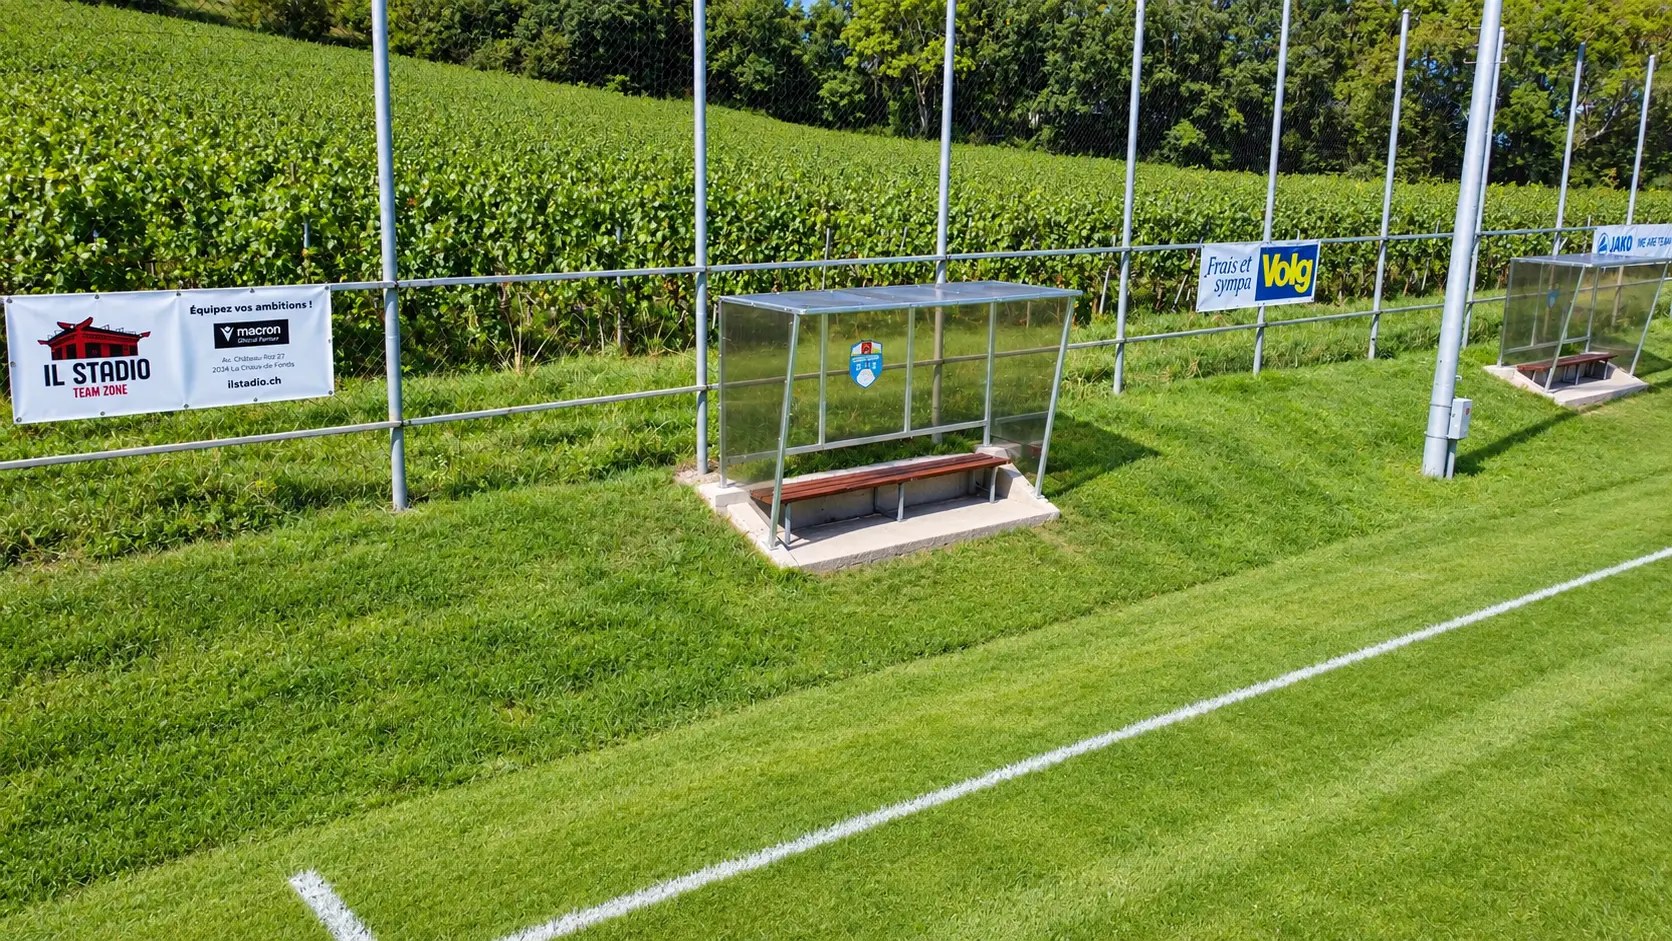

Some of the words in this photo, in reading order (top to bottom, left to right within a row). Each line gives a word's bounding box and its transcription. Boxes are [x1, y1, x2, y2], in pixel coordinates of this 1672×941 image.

[1609, 235, 1633, 252] JAKO
[1204, 256, 1238, 278] Frais
[1240, 256, 1252, 273] et
[1262, 253, 1313, 293] Volg
[1214, 277, 1252, 297] sympa
[190, 305, 232, 316] Équipez
[234, 305, 253, 313] vos
[255, 301, 307, 311] ambitions
[237, 326, 281, 336] macron
[44, 364, 65, 387] IL
[72, 358, 151, 385] STADIO
[73, 386, 101, 398] TEAM
[103, 384, 128, 396] ZONE
[227, 376, 282, 389] ilstadio.ch
